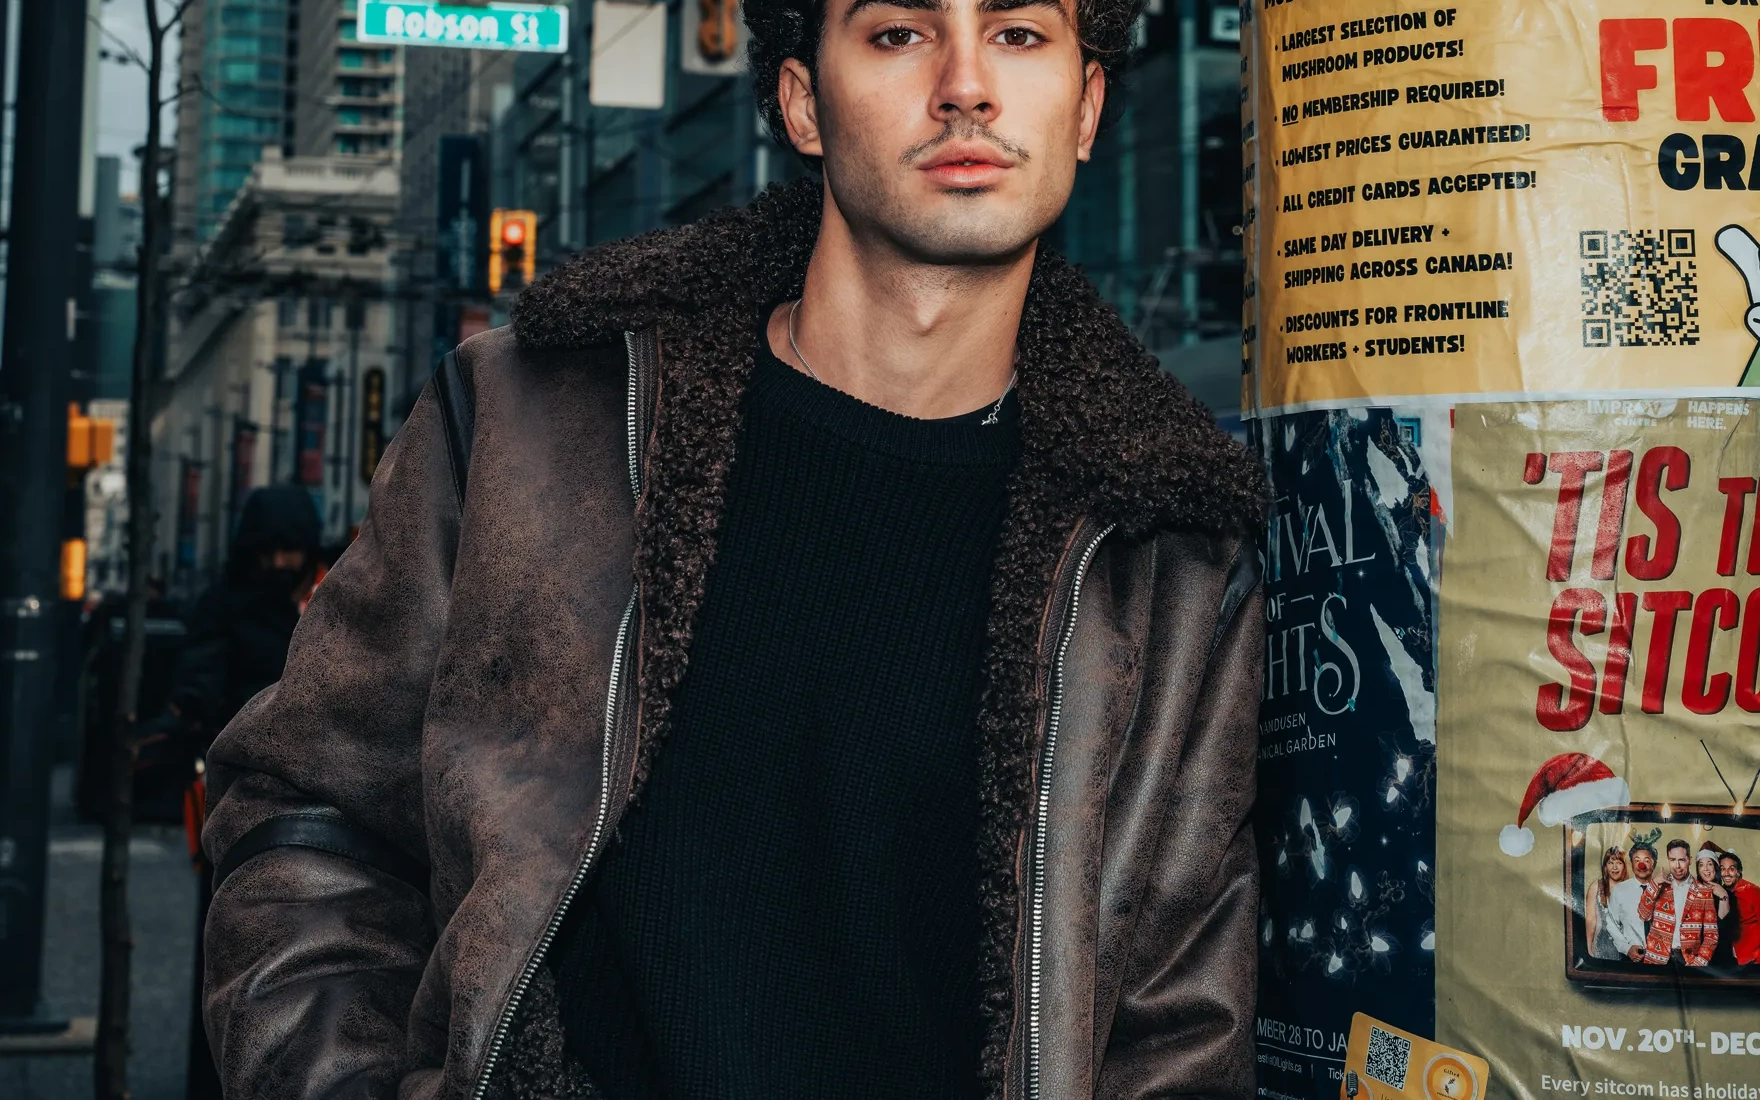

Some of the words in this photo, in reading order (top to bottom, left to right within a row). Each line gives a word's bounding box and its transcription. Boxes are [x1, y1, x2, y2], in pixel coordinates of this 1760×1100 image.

[385, 5, 499, 42] Robson
[510, 12, 539, 45] St
[1281, 24, 1336, 51] LARGEST
[1340, 11, 1427, 40] SELECTION
[1434, 8, 1457, 27] OF
[1282, 51, 1358, 82] MUSHROOM
[1363, 39, 1464, 68] PRODUCTS!
[1599, 18, 1760, 123] FR
[1282, 106, 1299, 124] NO
[1302, 88, 1399, 121] MEMBERSHIP
[1406, 78, 1505, 104] REQUIRED!
[1282, 143, 1331, 167] LOWEST
[1335, 134, 1392, 159] PRICES
[1399, 123, 1531, 150] GUARANTEED!
[1282, 194, 1303, 213] ALL
[1307, 185, 1356, 209] CREDIT
[1361, 179, 1420, 202] CARDS
[1427, 170, 1537, 196] ACCEPTED!
[1284, 236, 1317, 258] SAME
[1321, 232, 1347, 252] DAY
[1352, 224, 1434, 248] DELIVERY
[1284, 264, 1345, 289] SHIPPING
[1350, 257, 1418, 281] ACROSS
[1425, 252, 1513, 275] CANADA!
[1285, 308, 1359, 334] DISCOUNTS
[1365, 306, 1397, 325] FOR
[1404, 300, 1509, 322] FRONTLINE
[1286, 341, 1347, 365] WORKERS
[1365, 334, 1465, 358] STUDENTS!
[1687, 416, 1727, 430] HERE.
[1688, 401, 1749, 416] HAPPENS
[1523, 445, 1691, 582] 'TIS
[1266, 592, 1287, 623] OF
[1260, 592, 1361, 715] HTS
[1286, 734, 1336, 754] GARDEN
[1288, 1026, 1301, 1045] 28
[1303, 1028, 1324, 1049] TO
[1562, 1024, 1634, 1052] NOV.
[1542, 1075, 1590, 1097] Every
[1595, 1078, 1653, 1098] sitcom
[1659, 1081, 1689, 1099] has
[1694, 1086, 1703, 1100] a
